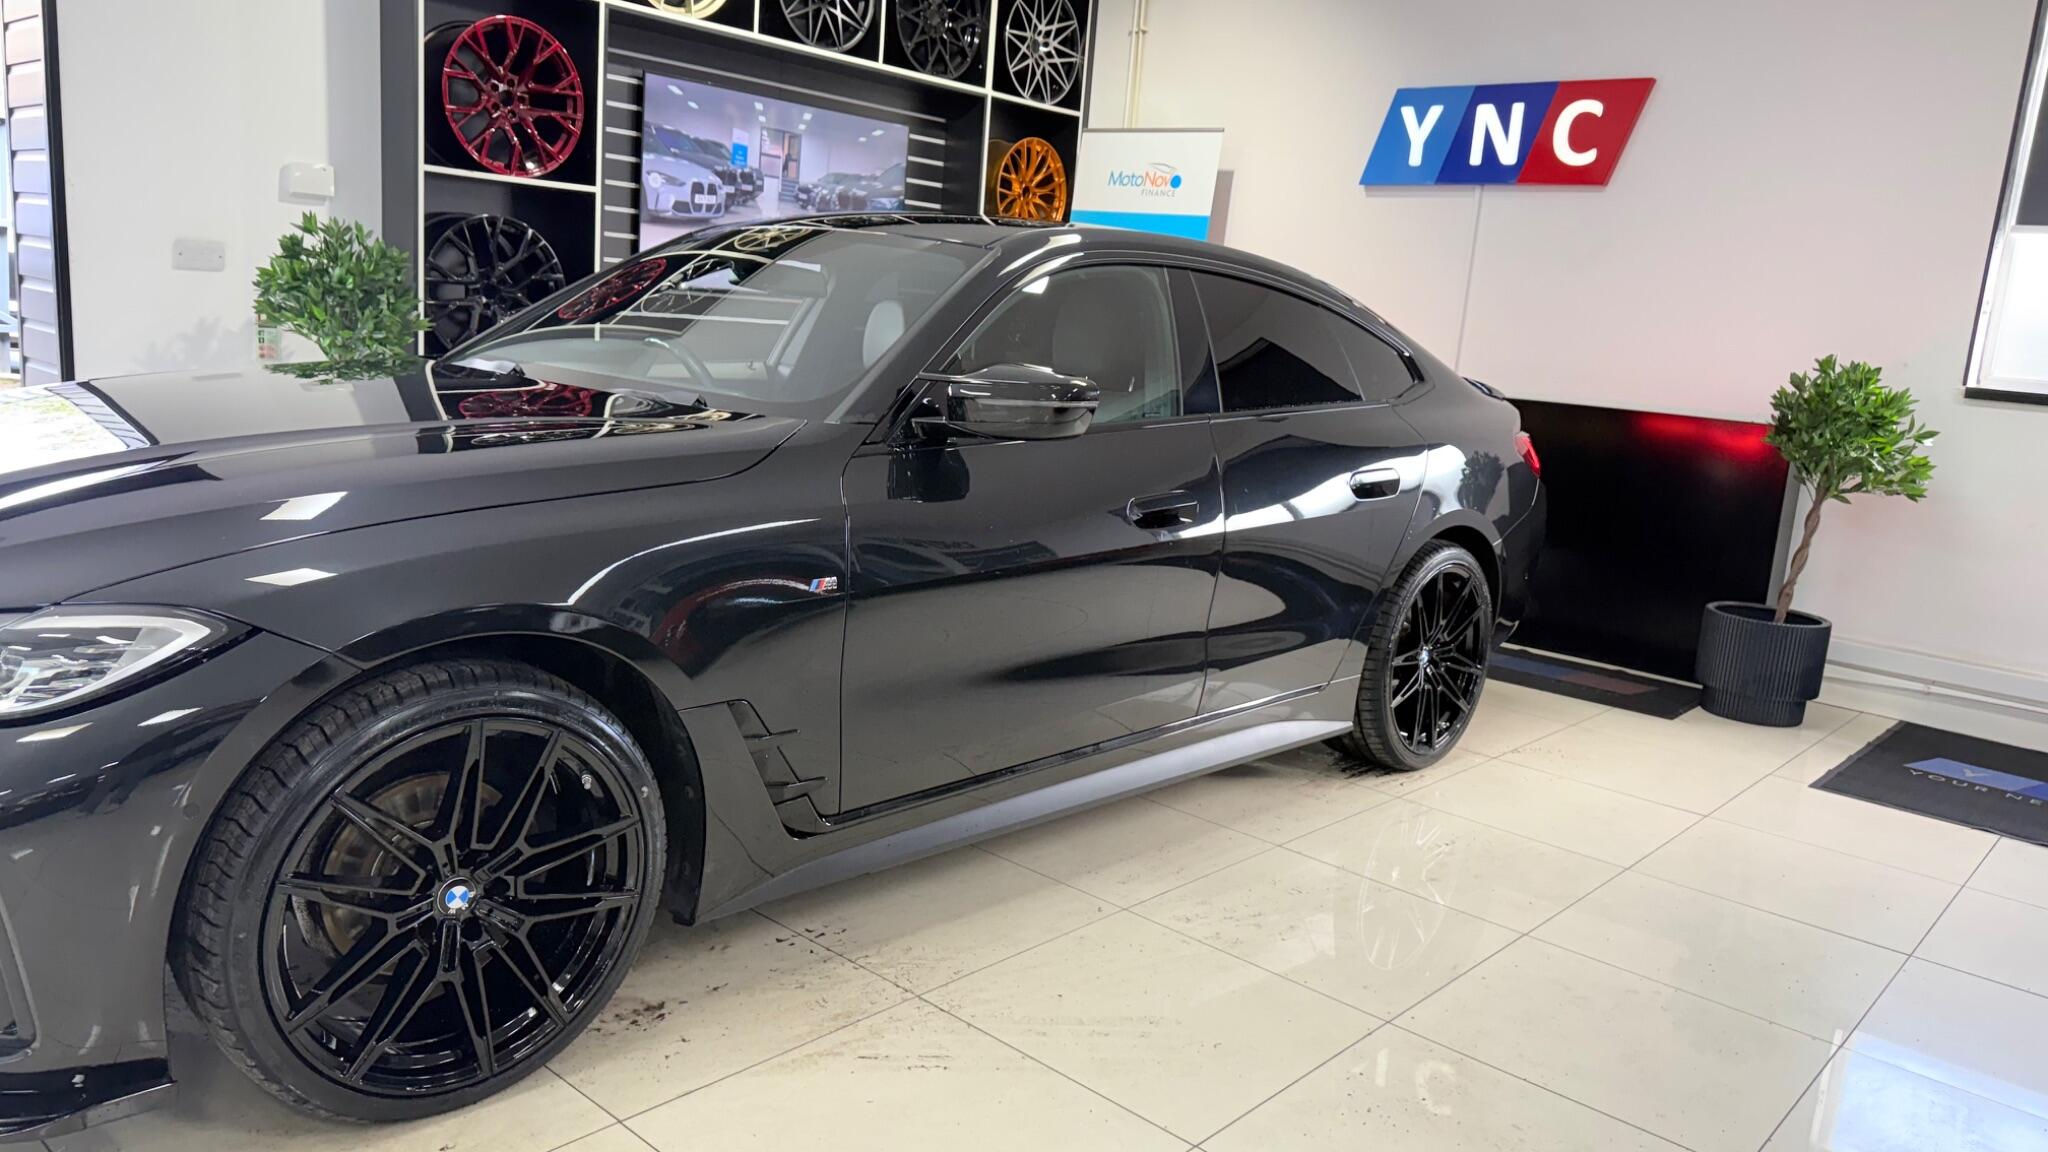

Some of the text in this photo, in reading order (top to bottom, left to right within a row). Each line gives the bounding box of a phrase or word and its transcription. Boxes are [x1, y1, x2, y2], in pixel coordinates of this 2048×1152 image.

[1400, 99, 1604, 167] YNC
[1141, 188, 1176, 197] FINANCE
[1909, 769, 1988, 792] YOUR
